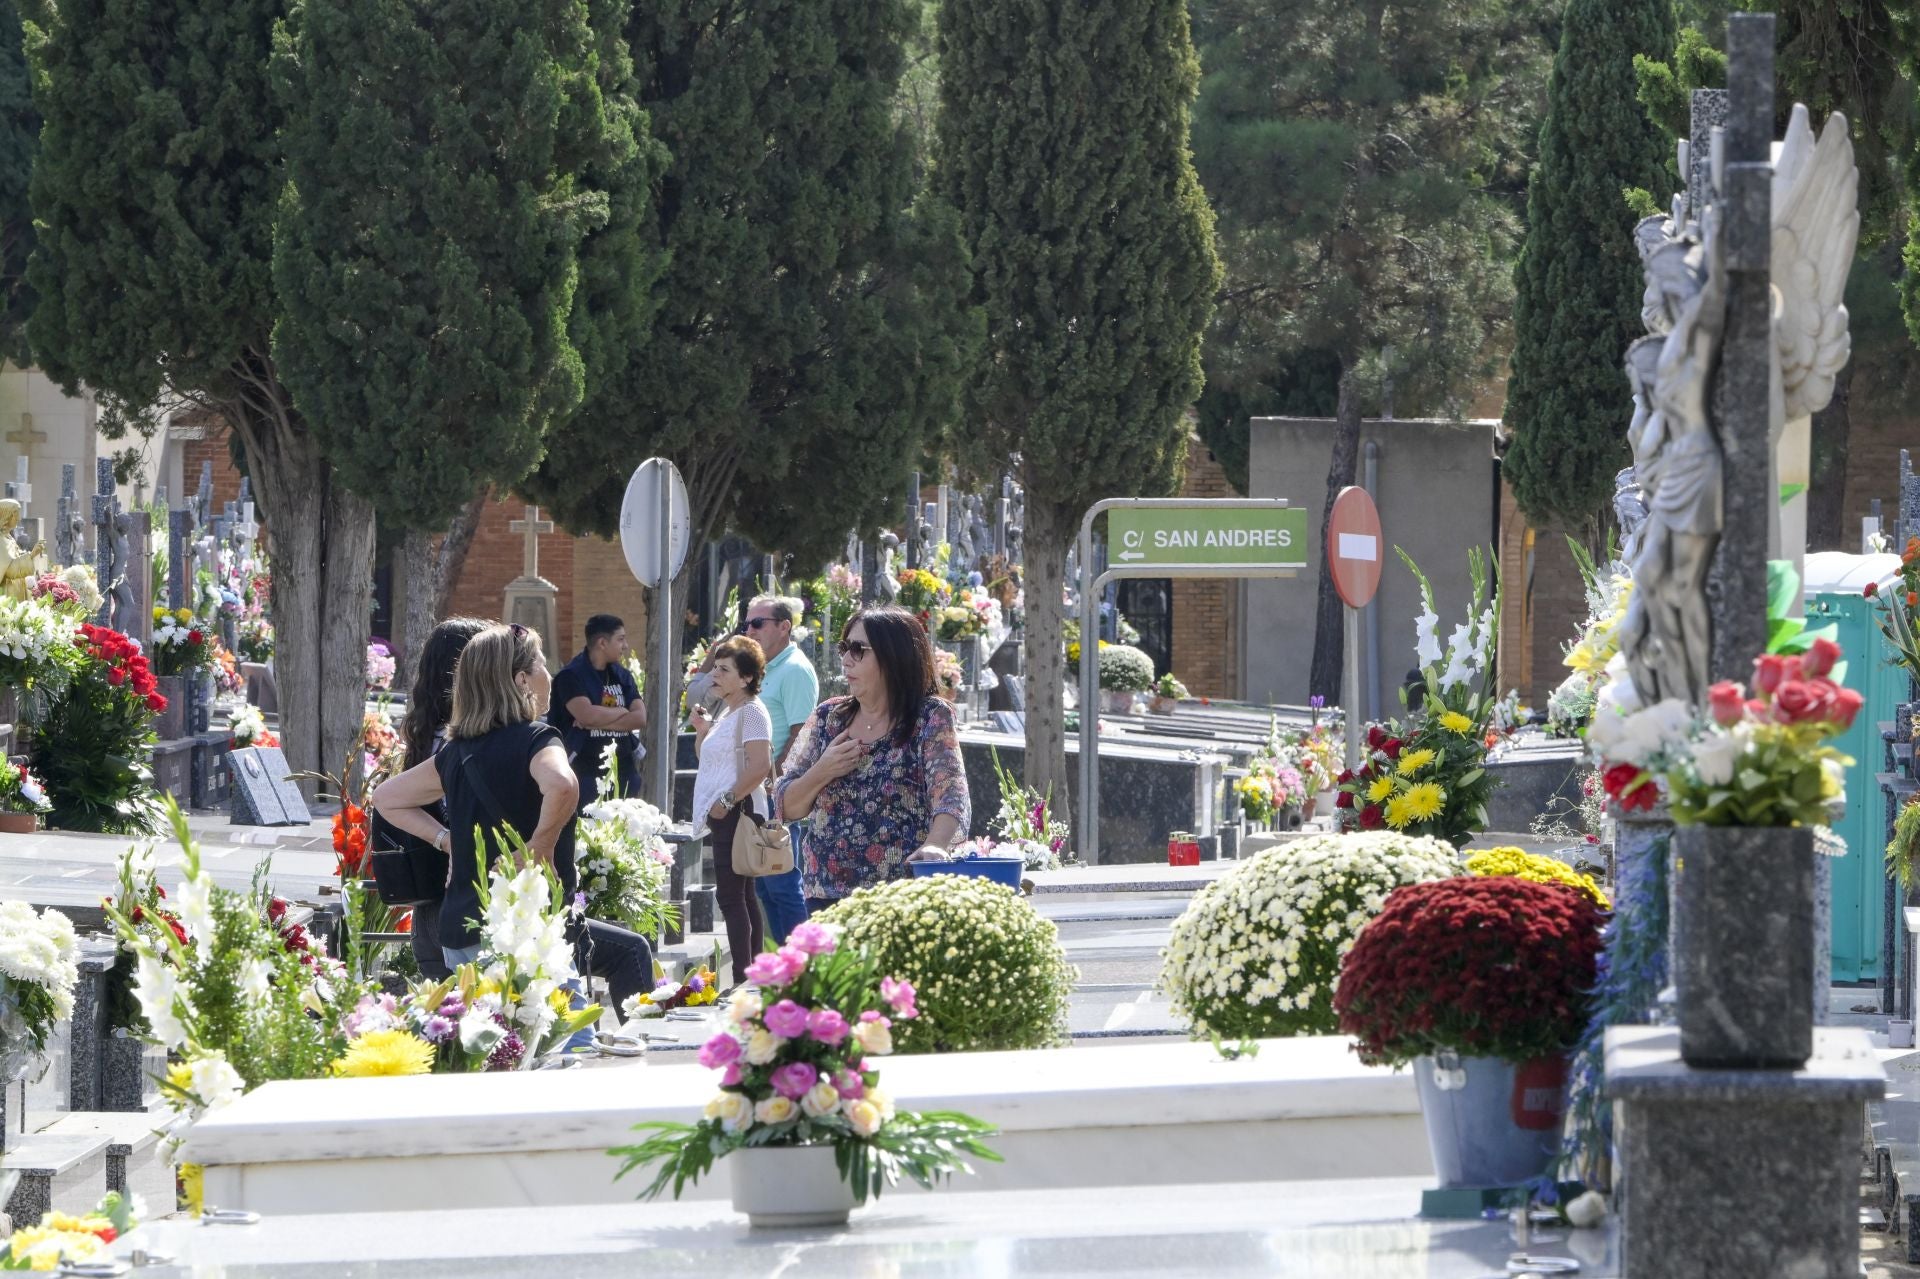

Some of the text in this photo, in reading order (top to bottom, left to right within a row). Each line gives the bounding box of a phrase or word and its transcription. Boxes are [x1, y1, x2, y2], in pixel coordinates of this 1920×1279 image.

[1123, 529, 1291, 548] C/ SAN ANDRES
